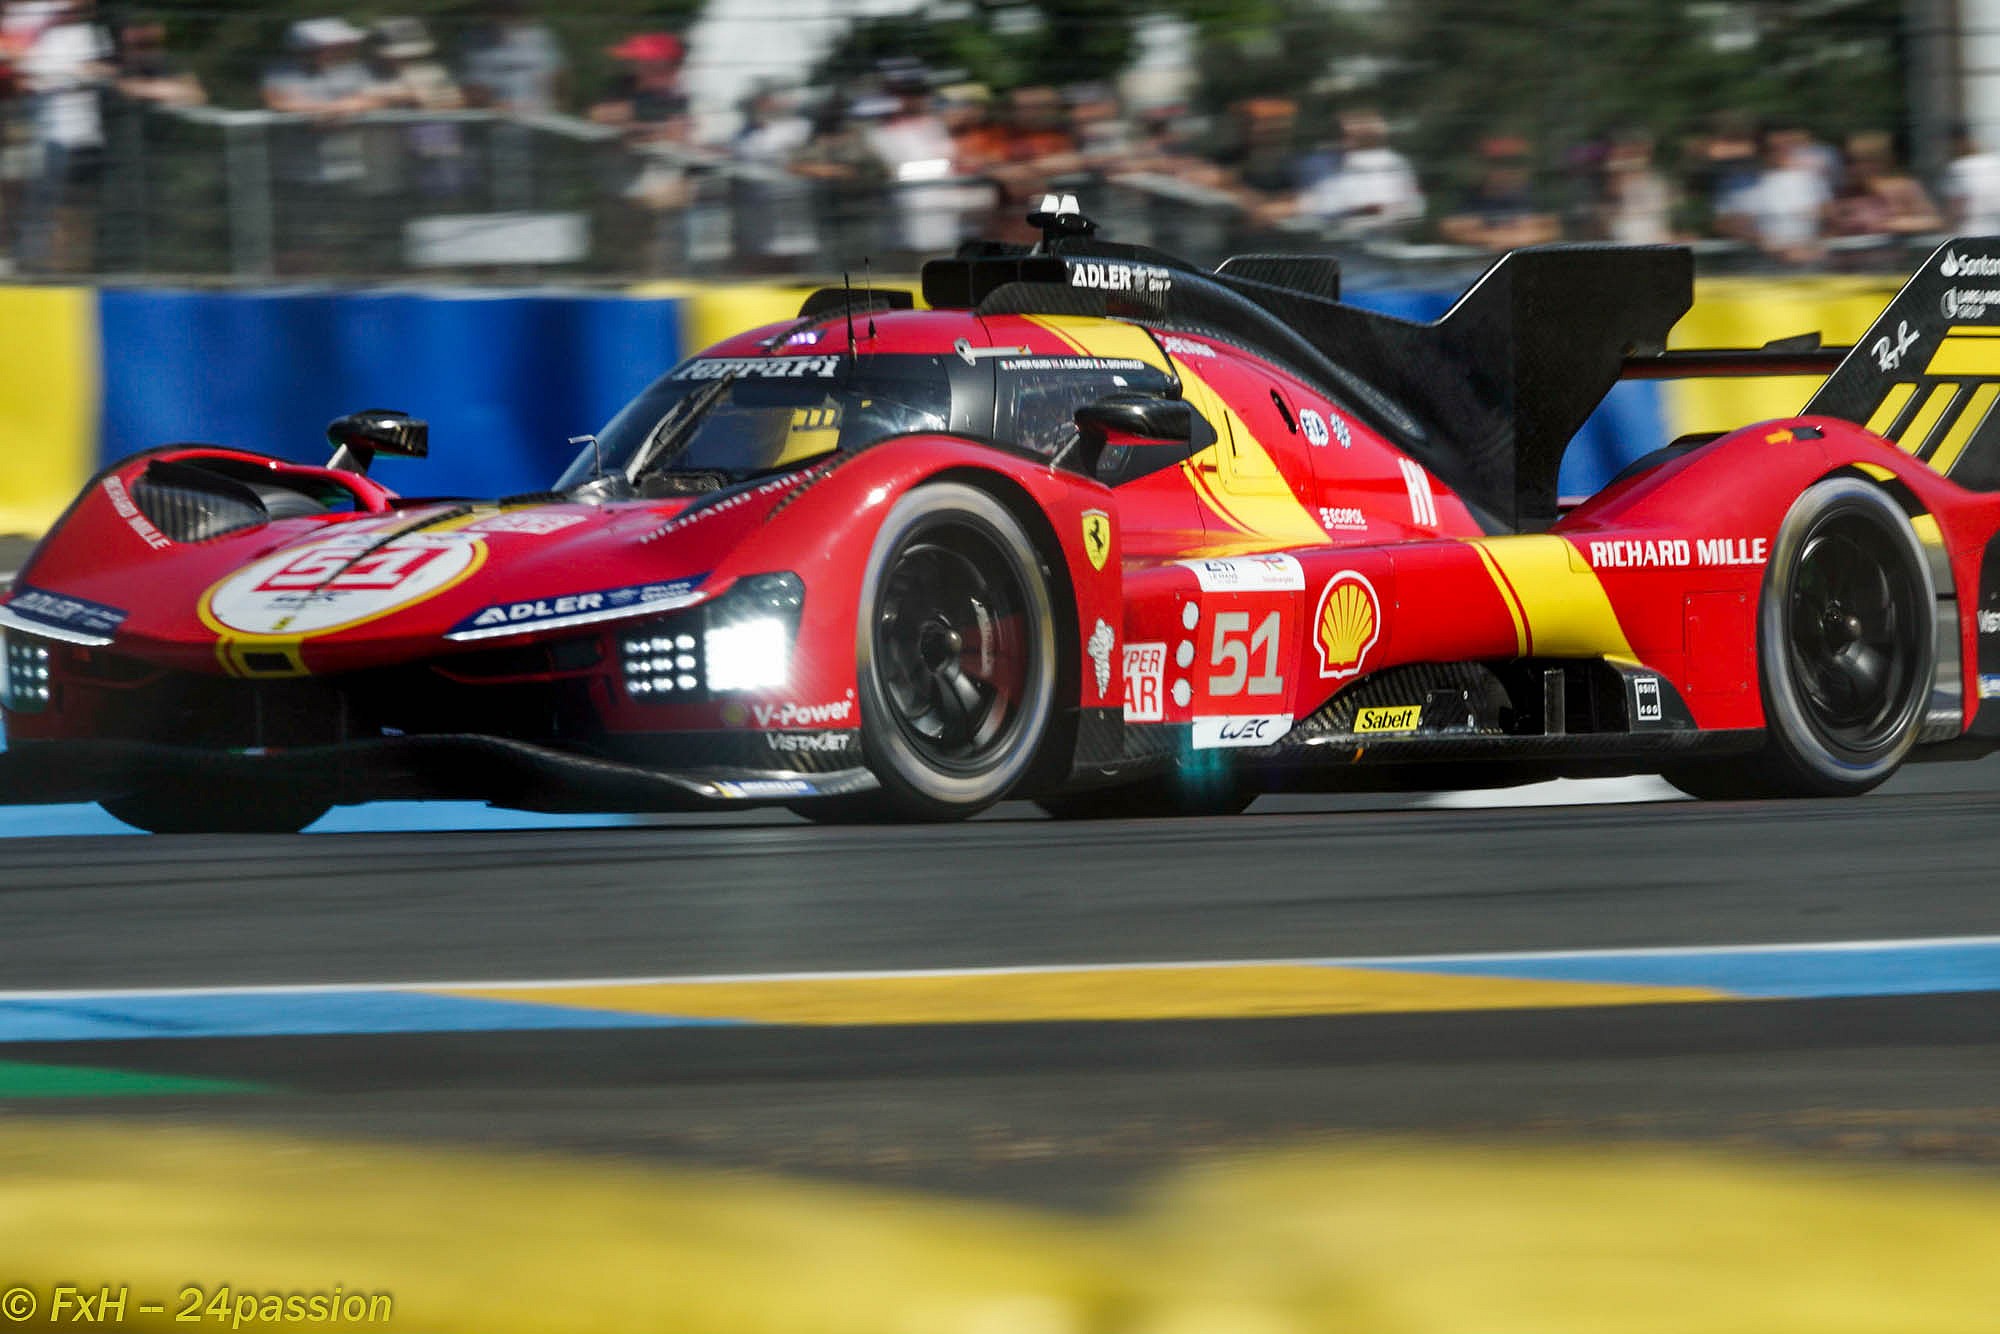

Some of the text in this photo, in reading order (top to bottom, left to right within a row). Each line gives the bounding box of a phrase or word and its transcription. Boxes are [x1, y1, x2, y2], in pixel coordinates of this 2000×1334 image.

[1072, 263, 1131, 290] ADLER
[671, 354, 840, 381] Ferrari
[1590, 538, 1767, 567] RICHARD MILLE
[473, 592, 604, 626] ADLER
[1123, 650, 1161, 673] PER
[1208, 611, 1284, 697] 51
[753, 700, 852, 728] V-Power
[1362, 709, 1413, 730] Sabelt
[1219, 719, 1269, 739] WEC
